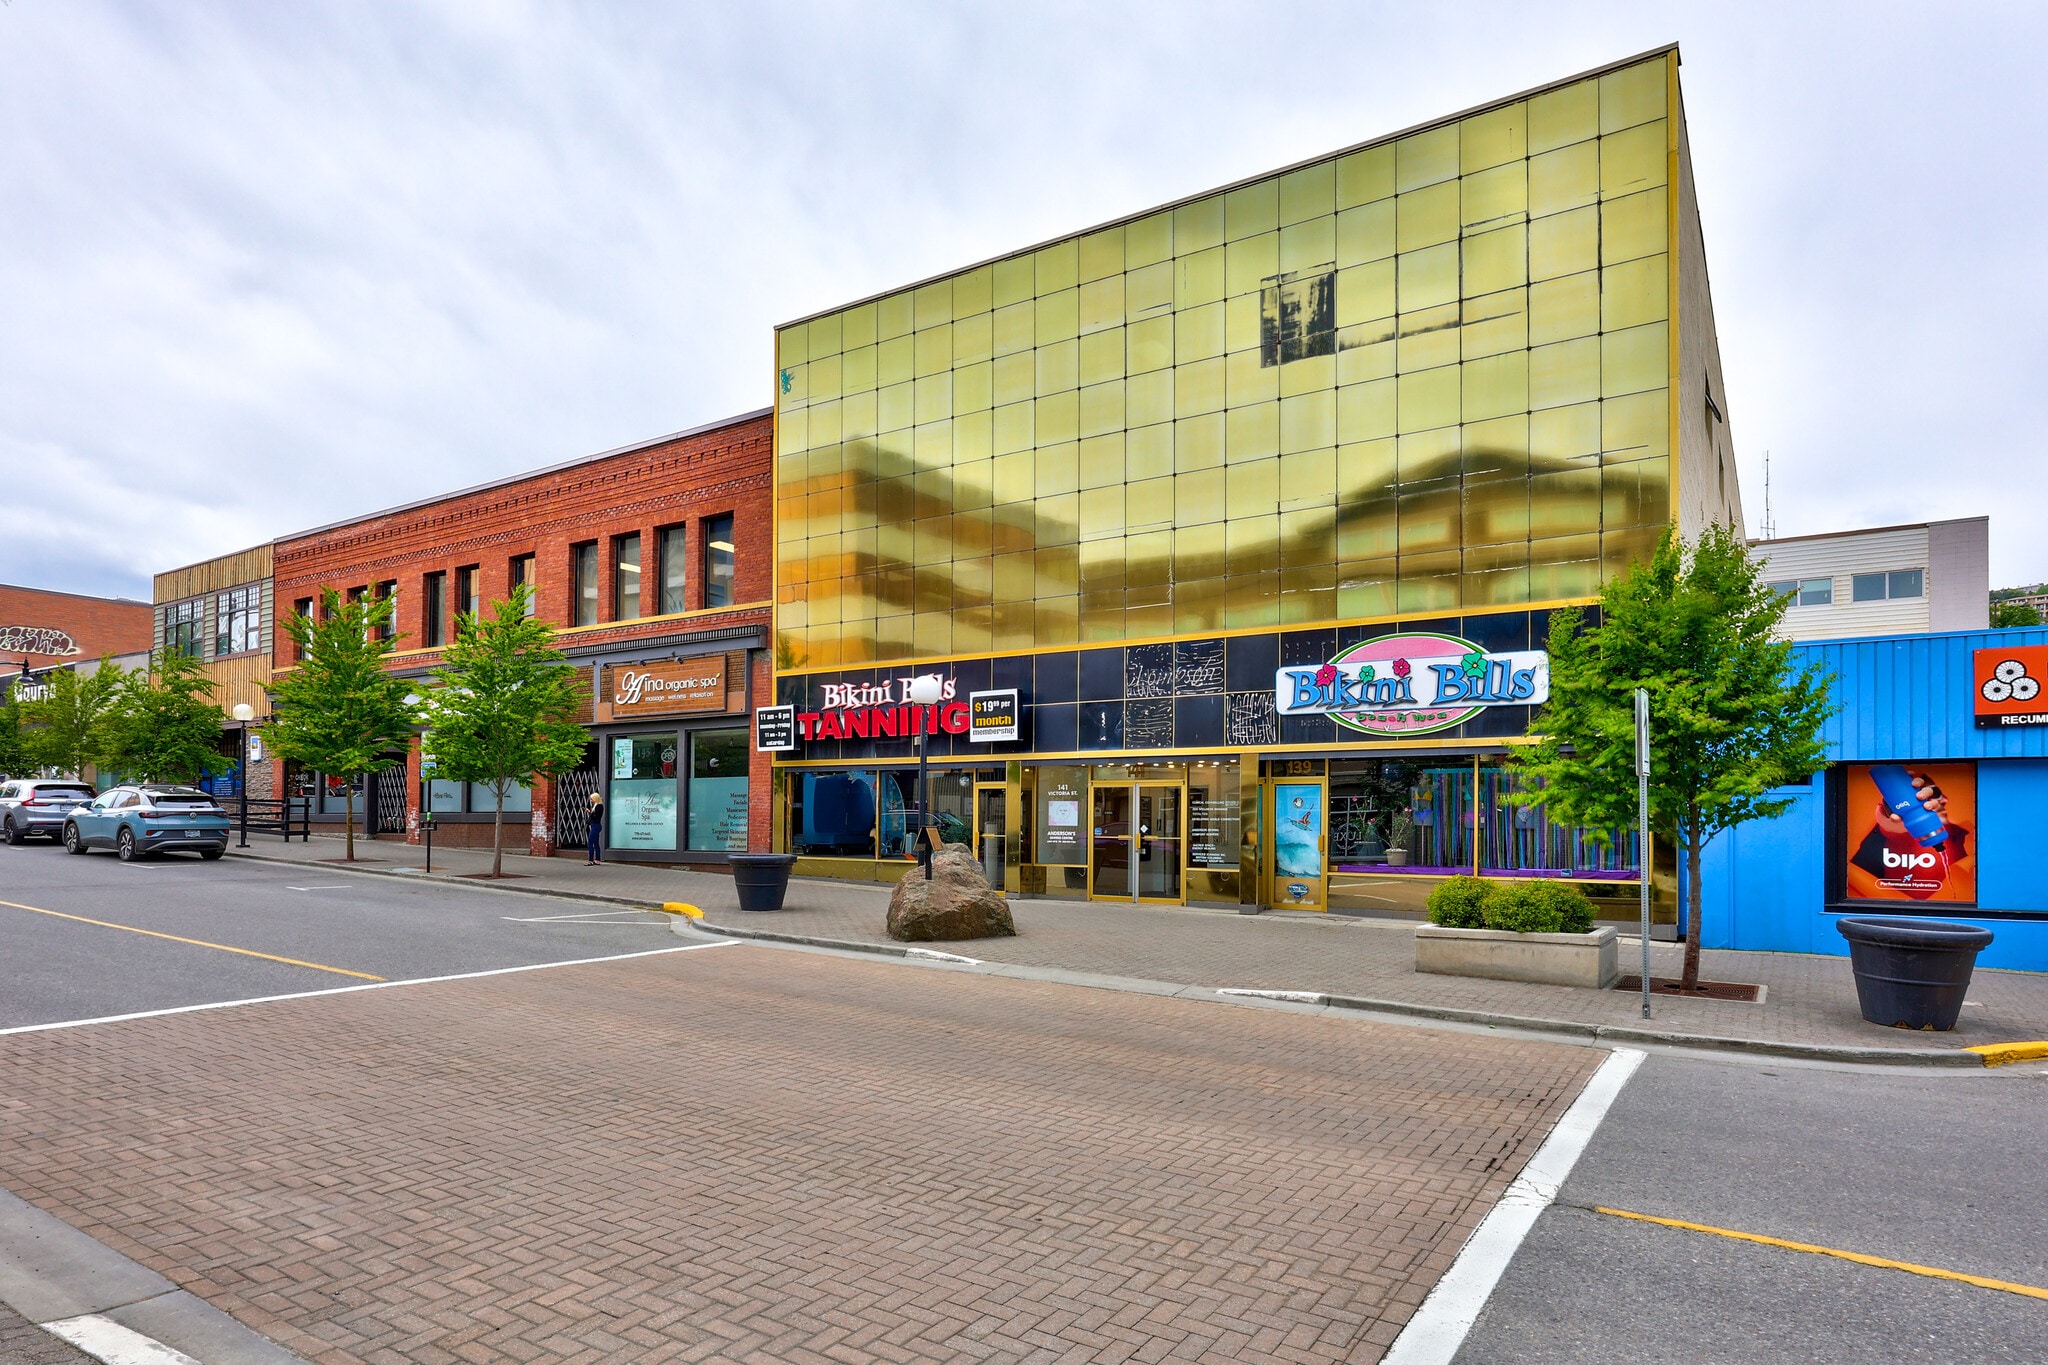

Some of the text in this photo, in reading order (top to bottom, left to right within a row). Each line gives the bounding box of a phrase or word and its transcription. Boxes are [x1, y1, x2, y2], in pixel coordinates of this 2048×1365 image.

[665, 677, 698, 692] organic
[700, 678, 717, 689] spa
[1286, 656, 1536, 709] Bikini Bills
[820, 673, 957, 710] Bikini Bls
[1000, 701, 1011, 709] per
[797, 701, 970, 741] TANNING
[975, 715, 1012, 727] month
[1357, 712, 1406, 723] beah
[972, 728, 1014, 736] membership
[1287, 760, 1312, 774] 139
[641, 806, 660, 814] Organic
[641, 813, 650, 821] Spa
